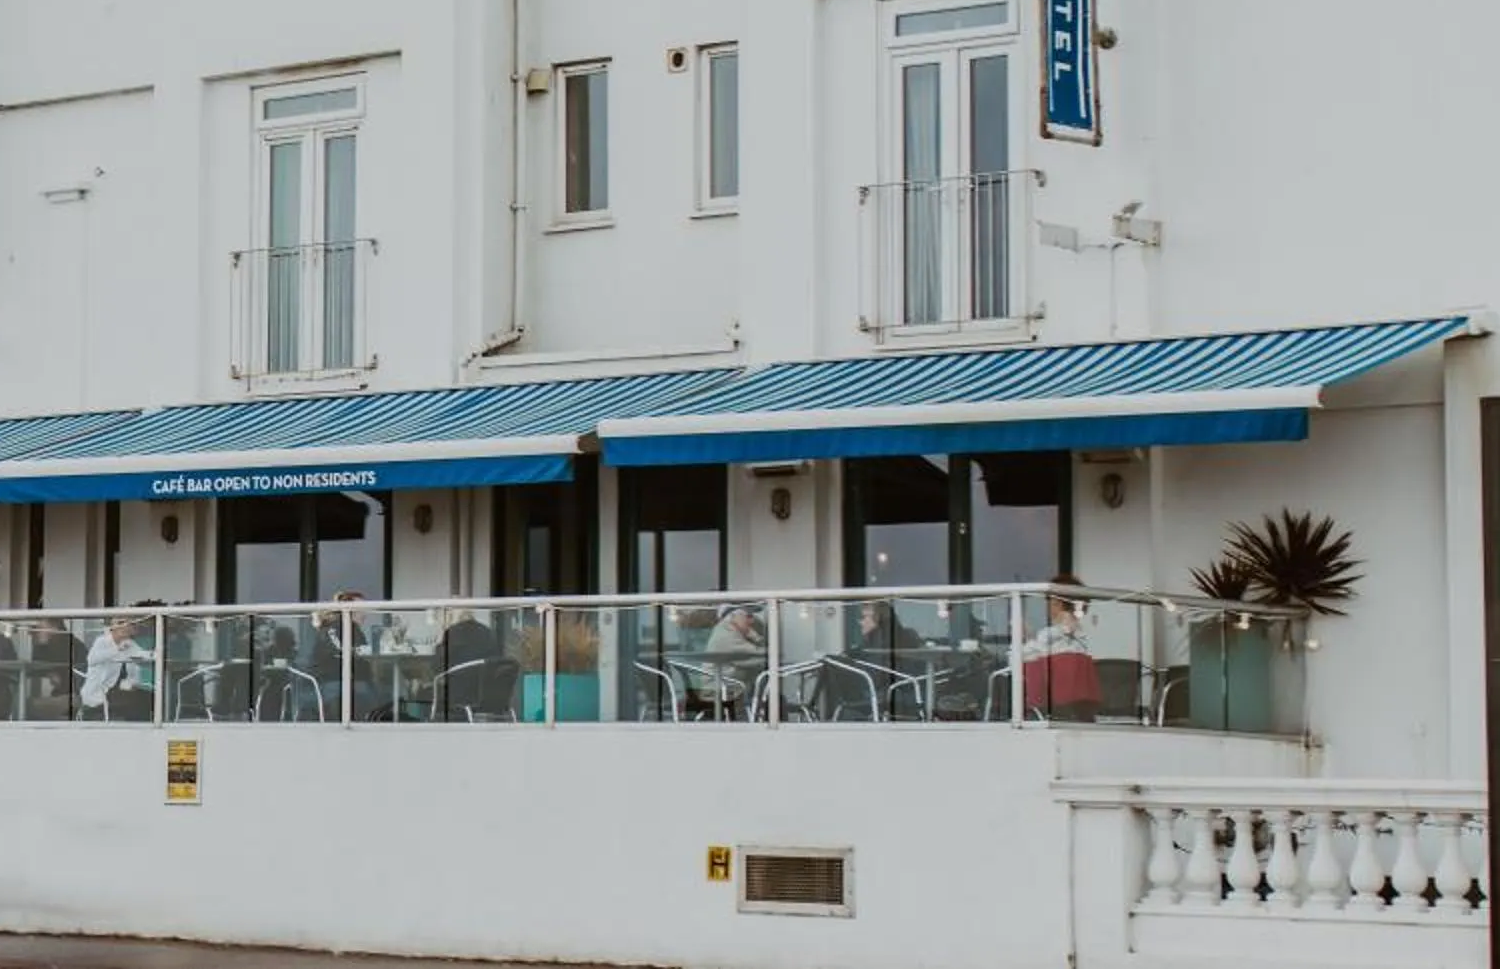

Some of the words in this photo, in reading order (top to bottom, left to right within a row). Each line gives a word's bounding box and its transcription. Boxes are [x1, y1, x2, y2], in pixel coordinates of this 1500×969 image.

[152, 474, 184, 494] CAFÉ
[187, 478, 212, 492] BAR
[213, 476, 250, 492] OPEN
[252, 475, 271, 490] TO
[273, 474, 302, 489] NON
[305, 471, 377, 488] RESIDENTS
